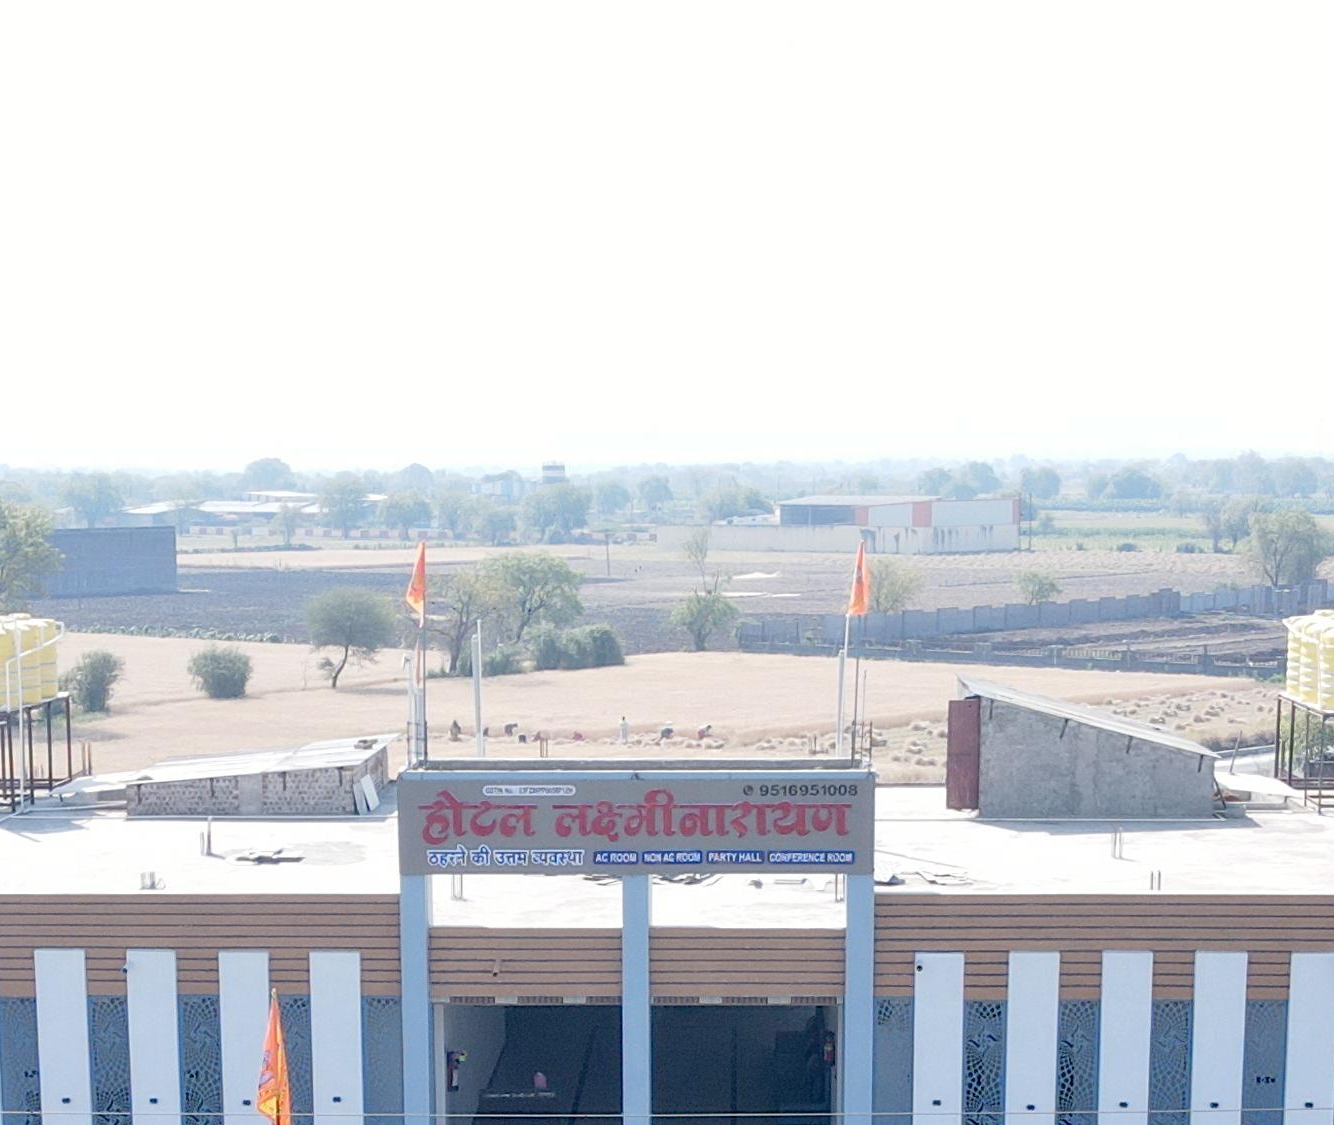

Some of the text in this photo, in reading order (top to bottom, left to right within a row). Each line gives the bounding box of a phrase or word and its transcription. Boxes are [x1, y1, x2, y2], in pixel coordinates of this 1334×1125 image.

[759, 785, 858, 797] 9516951008
[418, 788, 852, 845] होटल लक्ष्मीनारायण
[427, 844, 585, 867] ठहरने की उत्तम व्यवस्था
[595, 854, 636, 863] AC ROOM
[643, 853, 701, 863] NON AC ROOM
[708, 853, 761, 862] PARTY HALL
[769, 853, 852, 863] CONFERENCE ROOM
